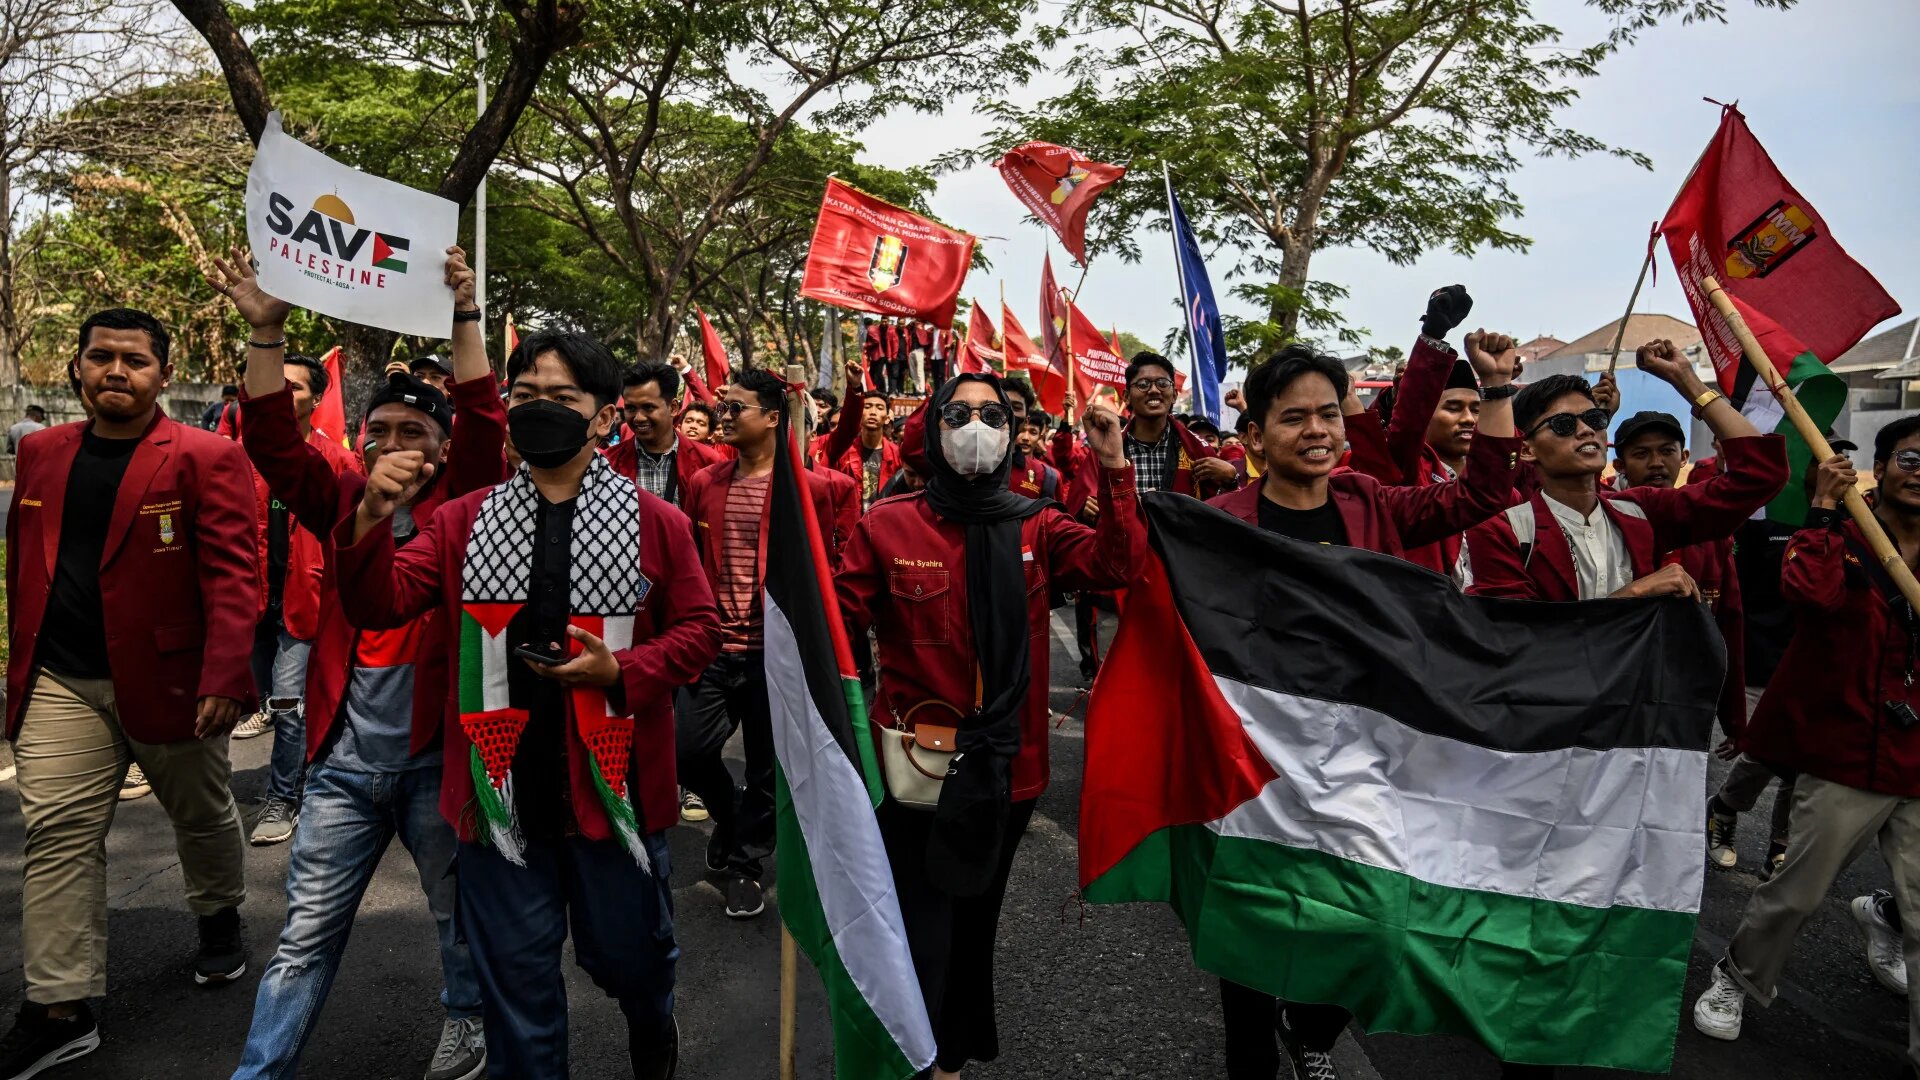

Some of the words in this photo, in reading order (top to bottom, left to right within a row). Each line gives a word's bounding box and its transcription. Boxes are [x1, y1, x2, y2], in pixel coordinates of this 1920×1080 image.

[825, 197, 855, 215] IKATAN
[855, 208, 901, 235] MAHASISWA
[898, 219, 931, 233] CABANG
[1766, 207, 1807, 246] IMM
[265, 191, 411, 275] SAVE
[269, 236, 386, 289] PALESTINE
[304, 269, 327, 283] PROTECT
[326, 277, 350, 290] AL-AQSA
[829, 287, 878, 304] KABUPATEN
[879, 299, 917, 315] SIDOARJO
[1086, 348, 1117, 363] PIMPINAN
[1080, 364, 1114, 381] KABUPATEN
[894, 557, 915, 567] Salwa
[916, 559, 943, 568] Syahira
